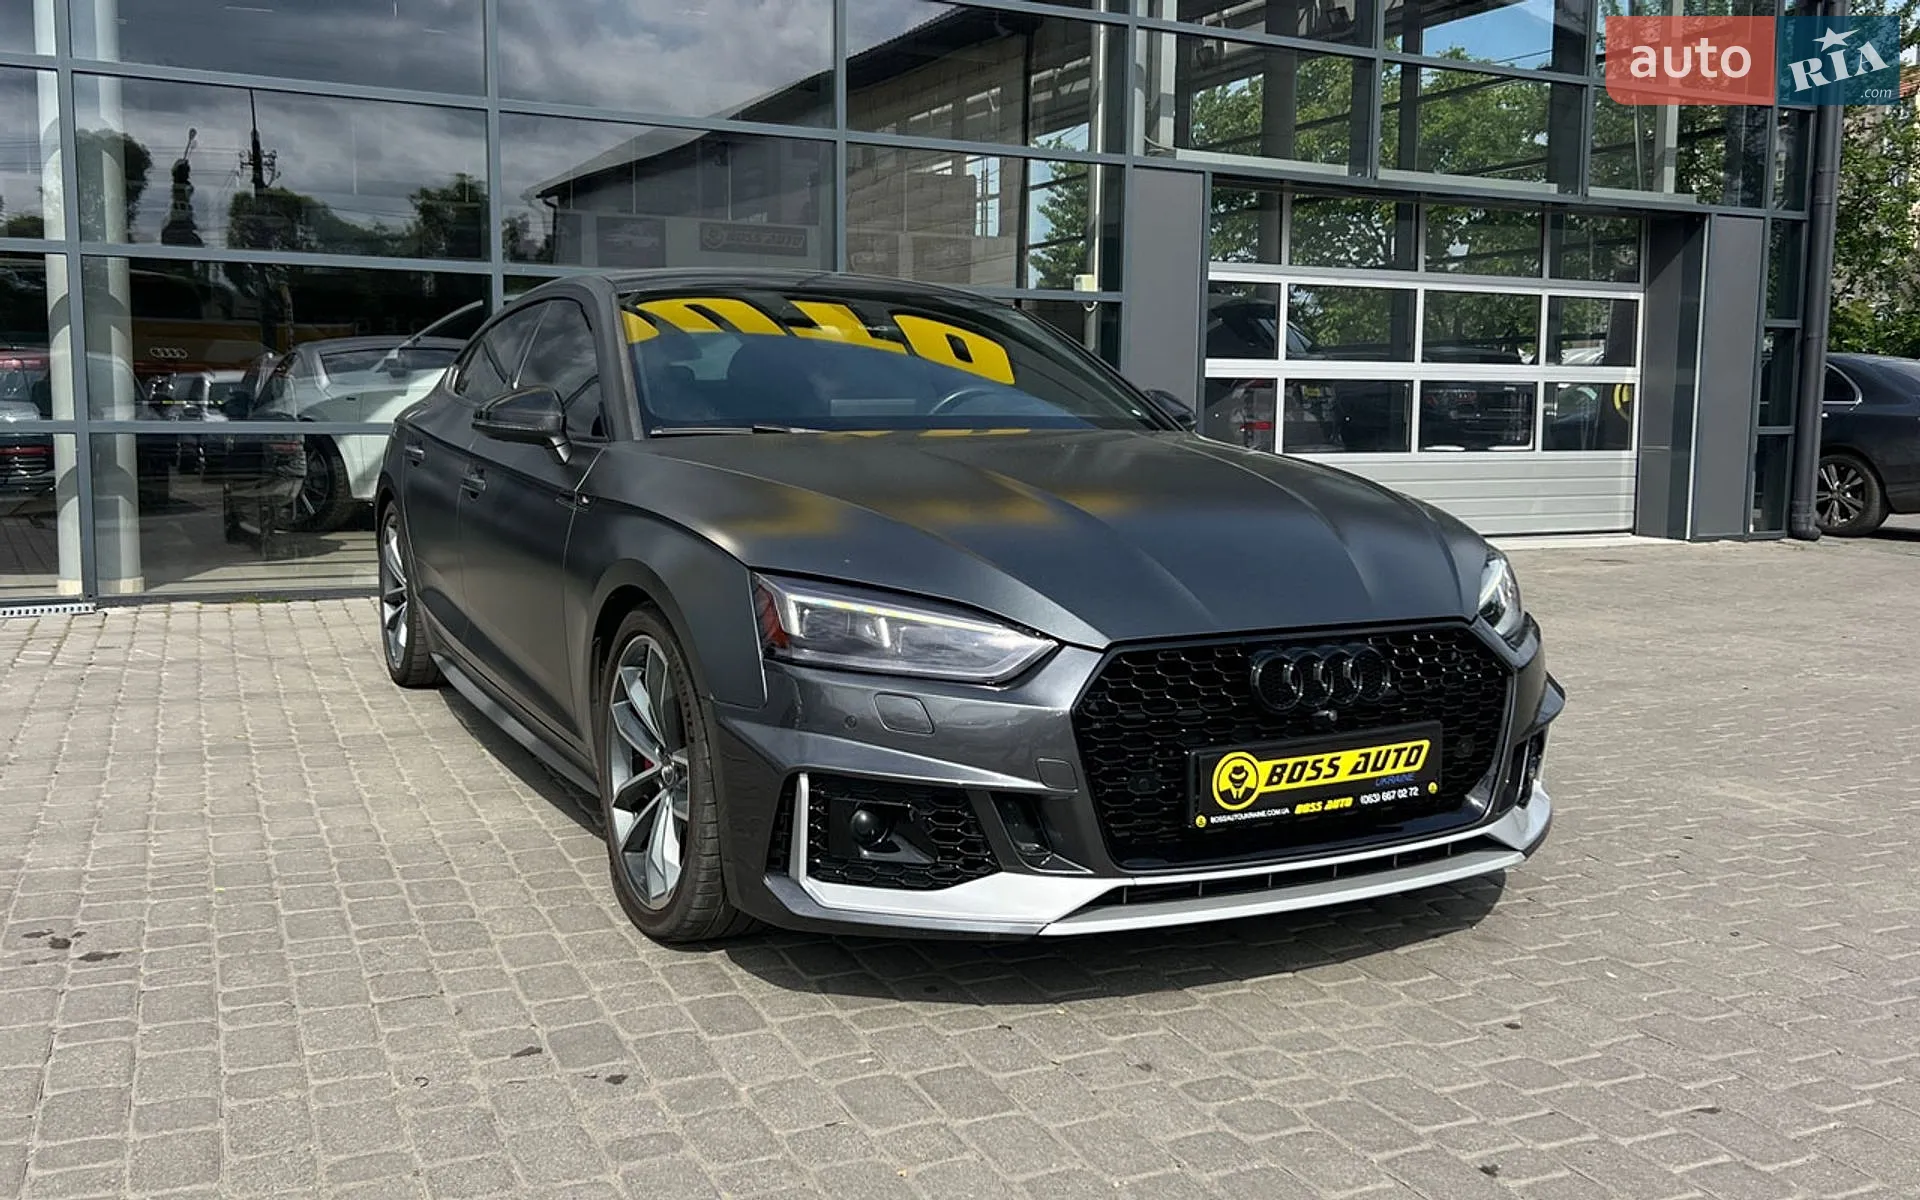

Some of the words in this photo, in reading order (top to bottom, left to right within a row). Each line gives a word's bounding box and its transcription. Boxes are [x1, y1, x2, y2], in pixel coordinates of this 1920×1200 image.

[1265, 756, 1341, 787] BOSS
[1349, 744, 1425, 776] AUTO
[1375, 773, 1415, 786] UKRAINE
[1408, 785, 1420, 797] 72
[1294, 802, 1323, 815] BOSS
[1324, 797, 1354, 810] AUTO
